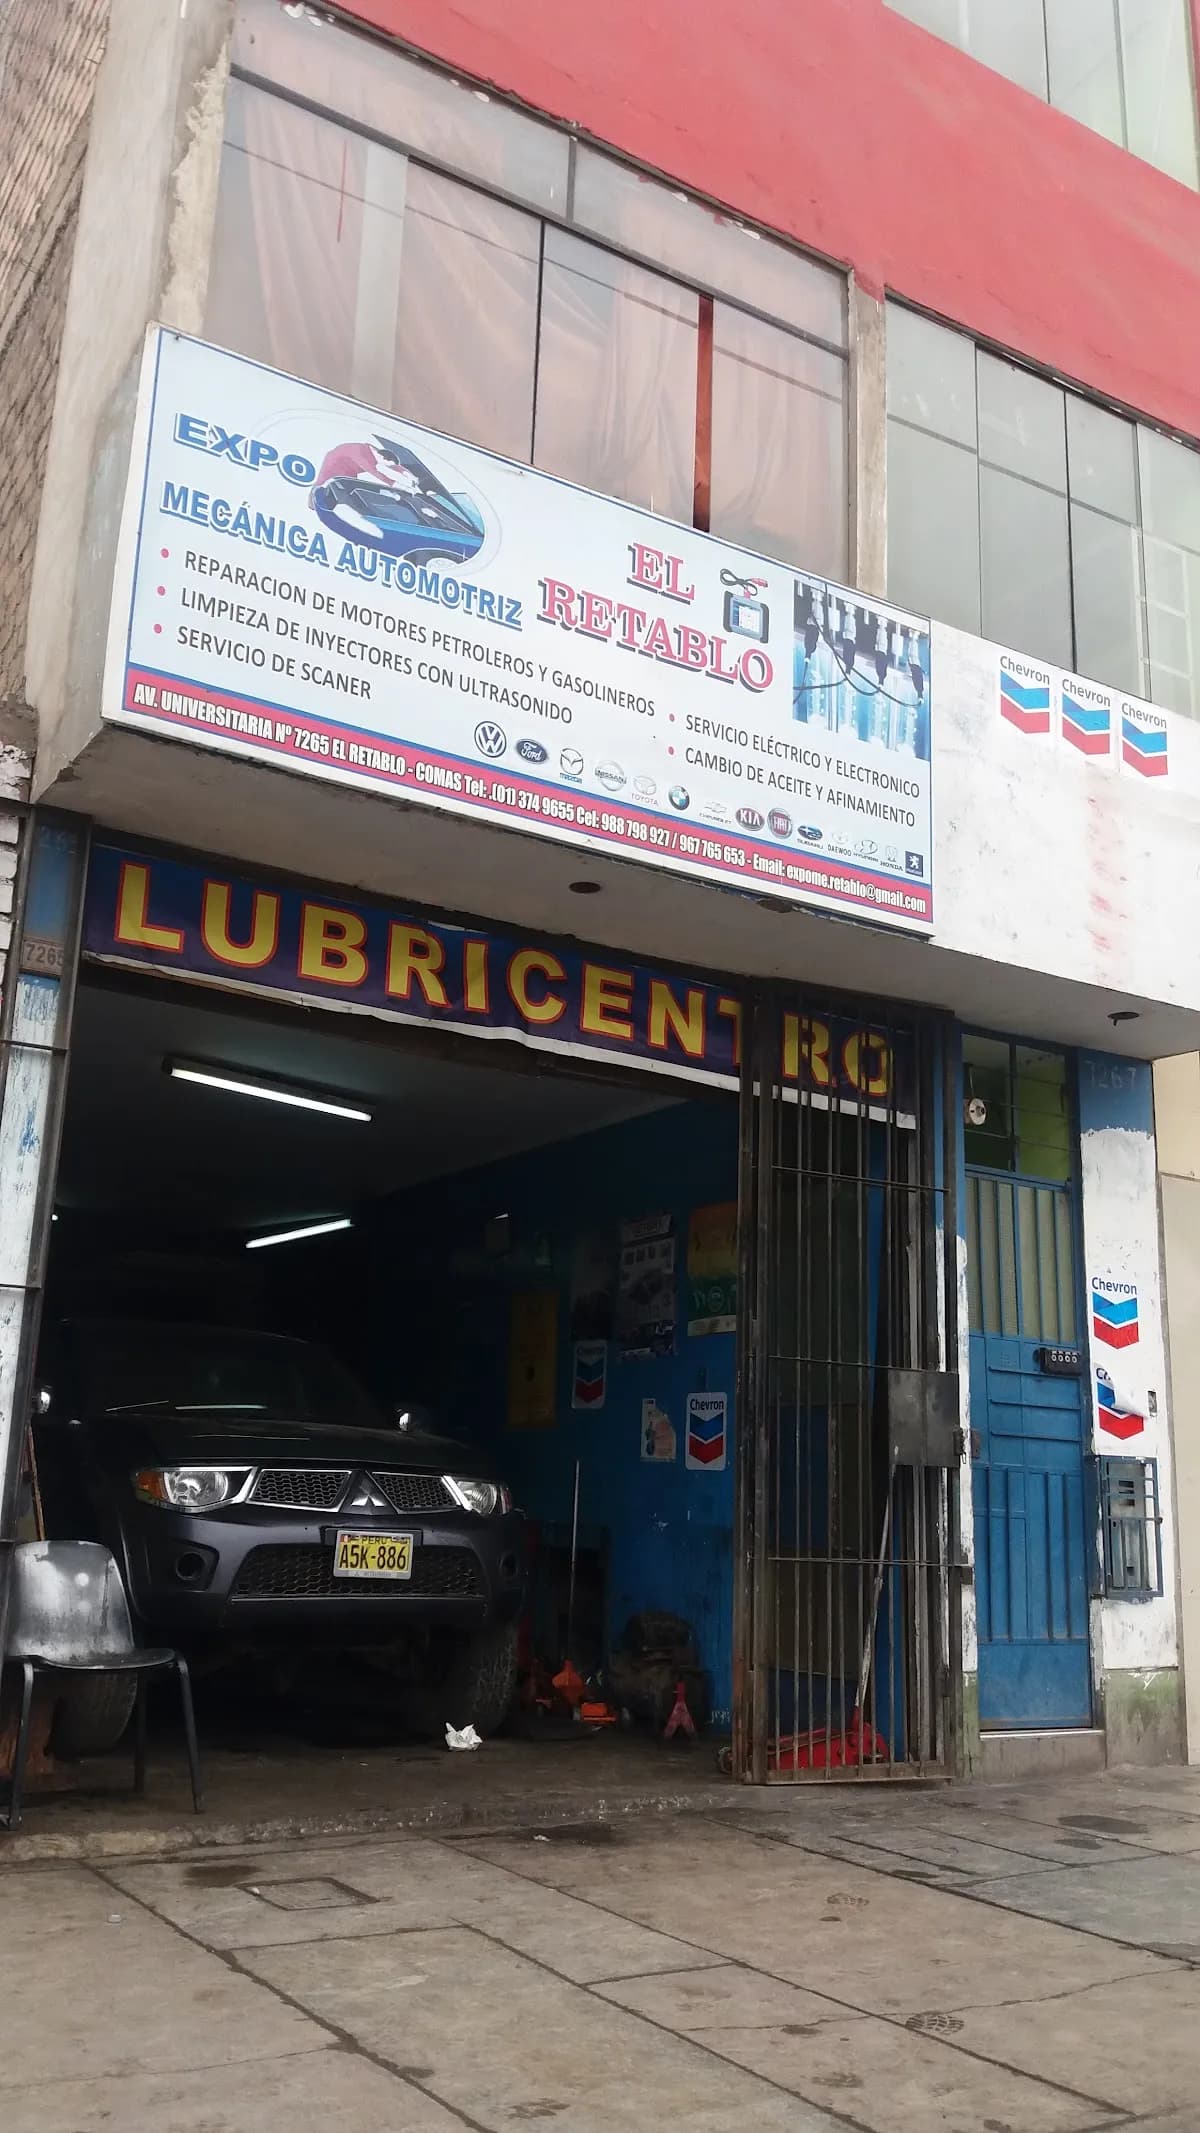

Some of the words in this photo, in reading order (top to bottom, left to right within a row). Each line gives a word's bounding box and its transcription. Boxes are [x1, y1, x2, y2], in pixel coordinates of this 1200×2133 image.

[174, 413, 316, 487] EXPO
[159, 481, 329, 568] MECÁNICA
[335, 542, 523, 632] AUTOMOTRIZ
[627, 542, 695, 604] EL
[181, 588, 270, 632] LIMPIEZA
[276, 617, 299, 640] DE
[305, 627, 412, 675] INYECTORES
[417, 661, 453, 688] CON
[459, 674, 571, 725] ULTRASONIDO
[184, 550, 306, 605] REPARACION
[312, 592, 335, 615] DE
[341, 601, 427, 644] MOTORES
[432, 630, 533, 678] PETROLEROS
[538, 665, 547, 682] Y
[552, 669, 654, 717] GASOLINEROS
[538, 577, 774, 693] RETABLO
[177, 625, 266, 668] SERVICIO
[272, 653, 295, 676] DE
[301, 662, 371, 699] SCANER
[1000, 655, 1050, 685] Chevron
[1061, 678, 1111, 707] Chevron
[1121, 702, 1167, 729] Chevron
[686, 713, 747, 747] SERVICIO
[753, 730, 820, 769] ELÉCTRICO
[824, 756, 831, 772] Y
[836, 759, 919, 799] ELECTRONICO
[134, 682, 158, 708] AV.
[160, 690, 273, 739] UNIVERSITARIA
[293, 727, 329, 755] 7265
[332, 738, 347, 760] EL
[349, 743, 405, 776] RETABLO
[416, 762, 462, 792] COMAS
[464, 774, 486, 798] Tel:
[518, 790, 542, 813] 374
[542, 796, 574, 822] 9655
[577, 806, 599, 829] Cel:
[602, 813, 623, 835] 988
[626, 820, 646, 841] 798
[650, 826, 669, 847] 927
[671, 831, 677, 850] /
[680, 834, 699, 855] 967
[702, 840, 721, 861] 765
[724, 845, 744, 867] 653
[754, 853, 784, 877] Email:
[787, 862, 925, 914] expome.retablo@gmail.com
[632, 793, 657, 805] TOYOTA
[685, 746, 741, 778] CAMBIO
[747, 764, 763, 784] DE
[768, 770, 811, 797] ACEITE
[816, 785, 822, 801] Y
[827, 787, 914, 828] AFINAMIENTO
[739, 808, 761, 827] KIA
[828, 844, 851, 856] DAEWOO
[24, 943, 65, 969] 7265
[1091, 1276, 1138, 1295] Chevron
[689, 1398, 724, 1411] Chevron
[339, 1544, 407, 1570] A5K-886
